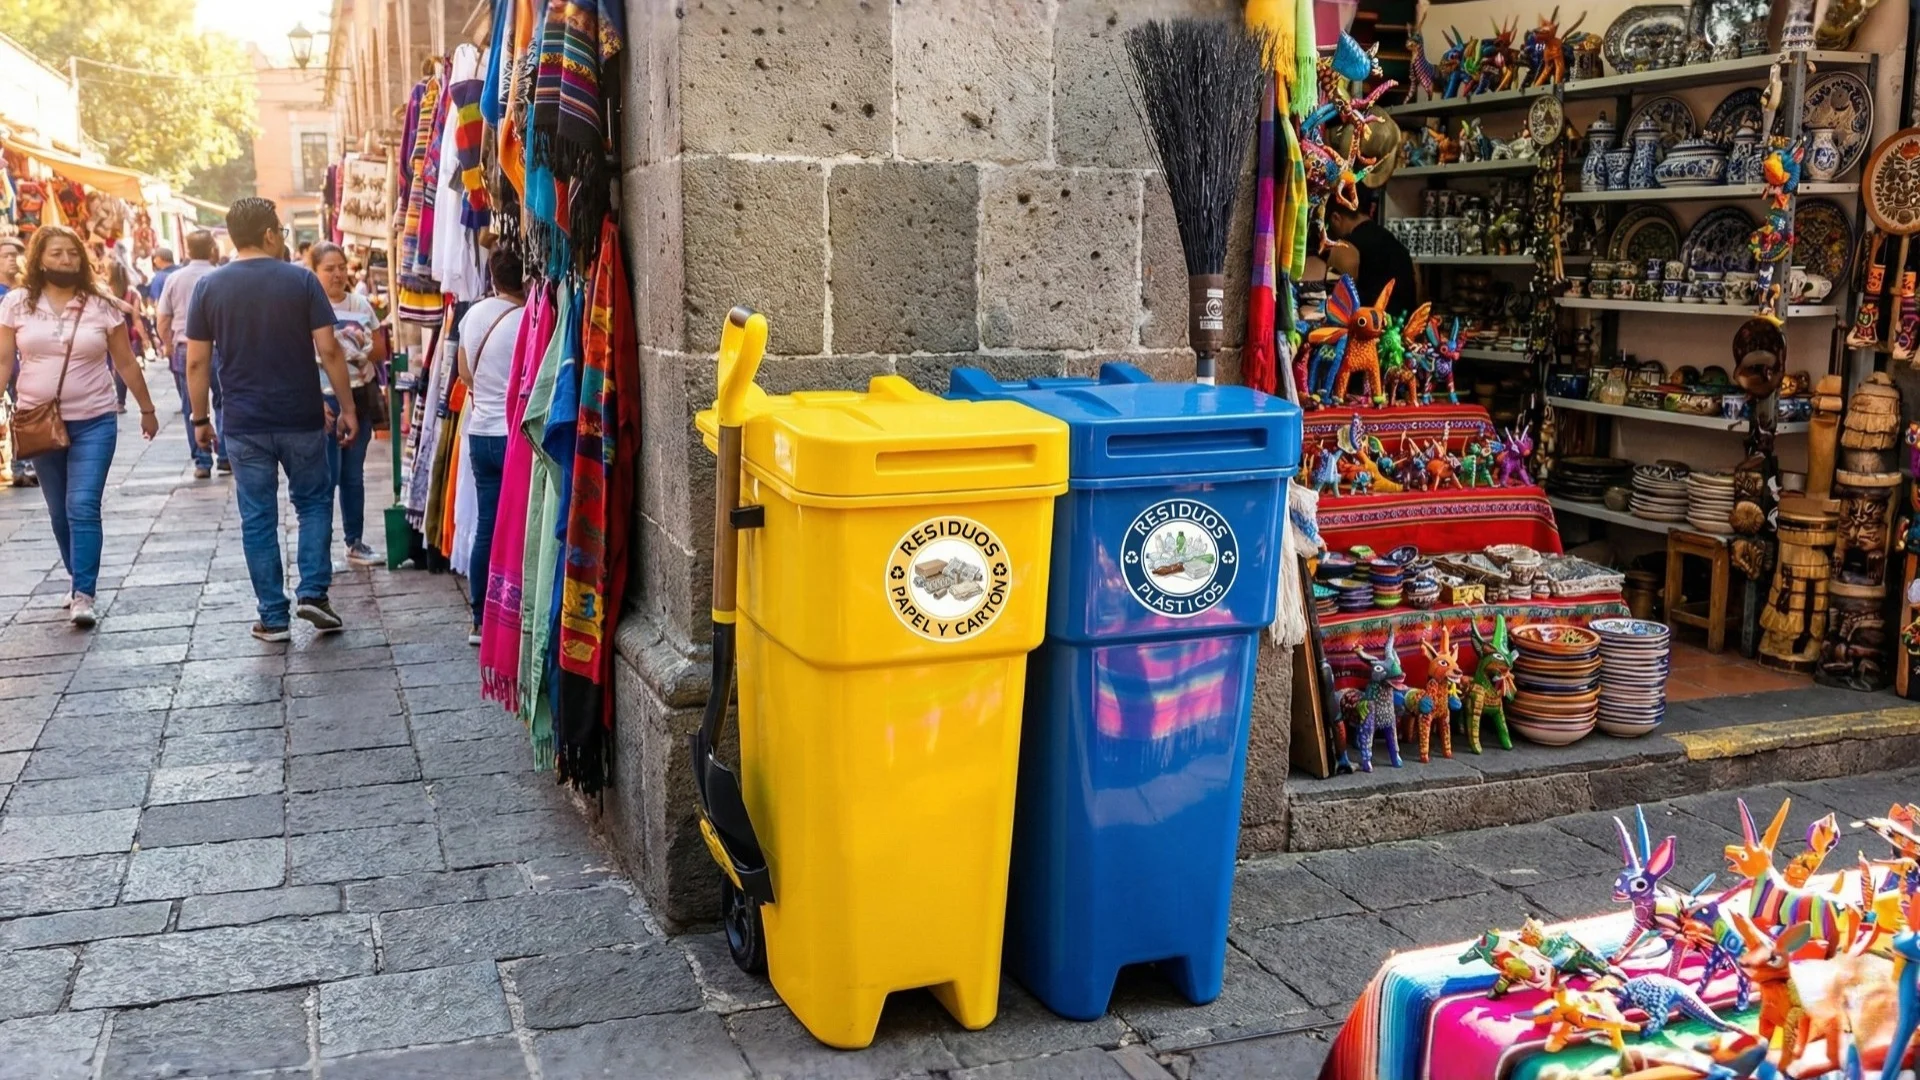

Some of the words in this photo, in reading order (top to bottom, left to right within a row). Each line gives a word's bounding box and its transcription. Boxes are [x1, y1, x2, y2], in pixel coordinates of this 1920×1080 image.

[900, 521, 1000, 557] RESIDUOS
[1134, 503, 1228, 539] RESIDUOS
[892, 586, 930, 633] PAPEL
[937, 623, 949, 636] Y
[955, 579, 1007, 635] CARTÓN
[1137, 581, 1224, 612] PLÁSTICOS
